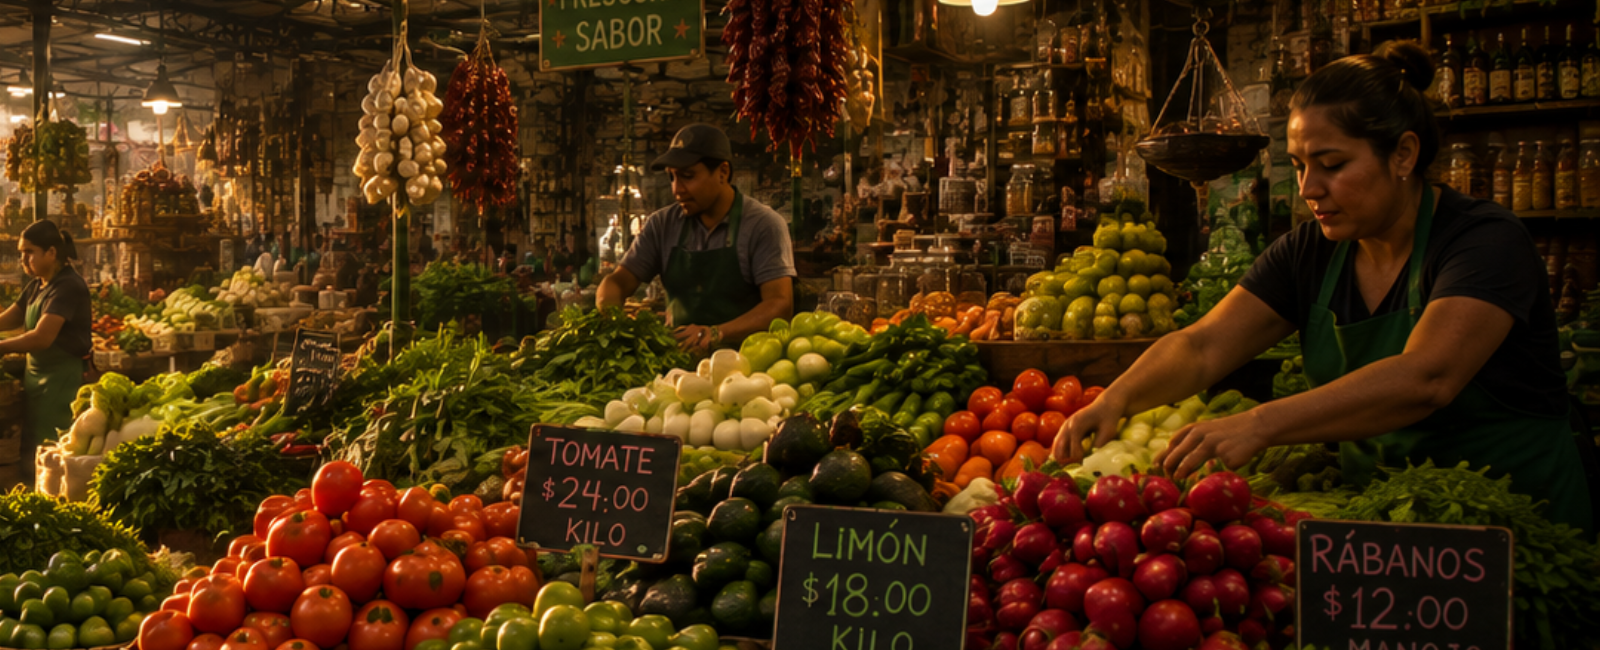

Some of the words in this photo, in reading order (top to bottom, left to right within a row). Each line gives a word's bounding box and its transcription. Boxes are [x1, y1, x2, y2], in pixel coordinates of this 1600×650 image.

[575, 14, 663, 52] SABOR
[545, 437, 655, 474] TOMATE
[565, 517, 626, 546] KILO
[1310, 529, 1486, 582] RÁBANOS
